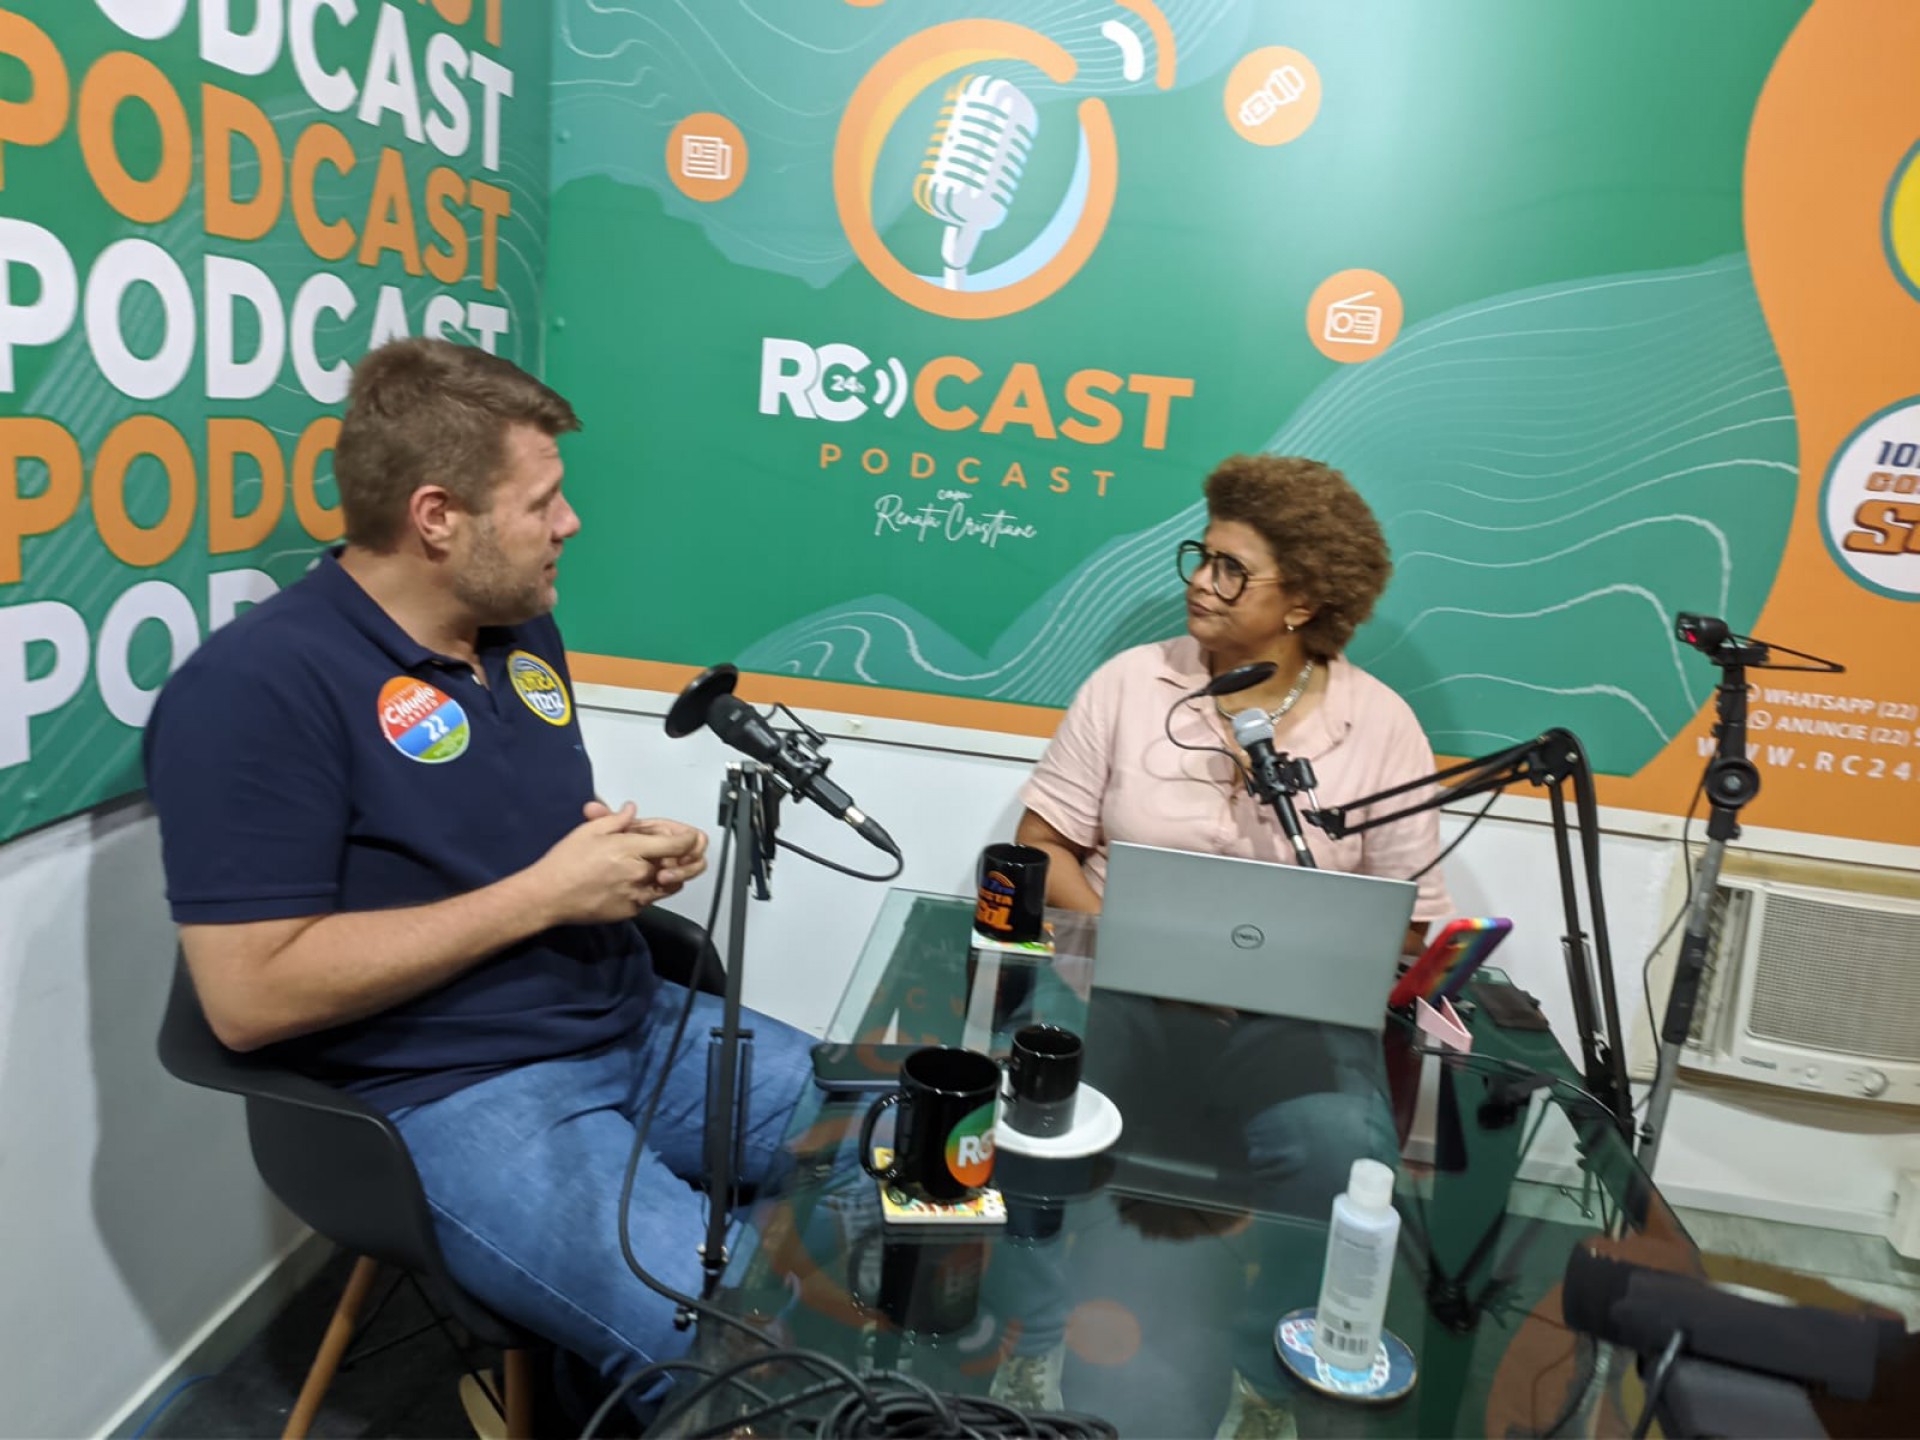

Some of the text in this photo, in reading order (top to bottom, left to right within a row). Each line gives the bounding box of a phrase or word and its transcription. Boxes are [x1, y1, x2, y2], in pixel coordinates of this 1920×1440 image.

[0, 8, 511, 291] PODCAST
[914, 356, 1195, 450] CAST
[820, 443, 1116, 497] PODCAST
[1877, 440, 1920, 468] 10
[1764, 688, 1918, 721] WHATSAPP (22)
[419, 714, 450, 742] 22
[1775, 716, 1869, 741] ANUNCIE
[1870, 727, 1911, 746] (22)
